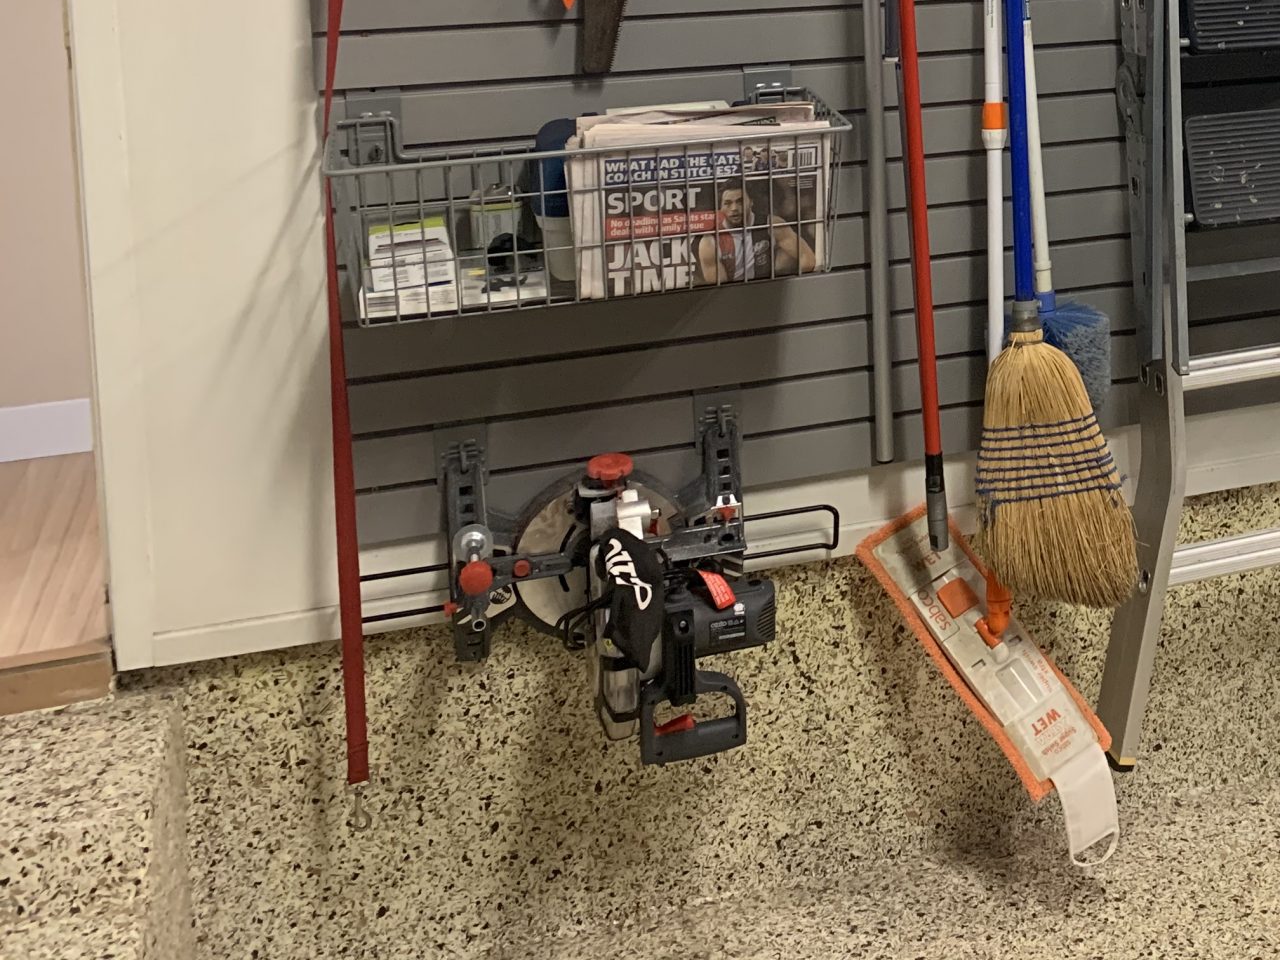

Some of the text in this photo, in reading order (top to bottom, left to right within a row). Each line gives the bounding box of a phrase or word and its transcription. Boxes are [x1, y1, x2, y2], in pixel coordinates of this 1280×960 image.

[607, 187, 702, 215] SPORT
[608, 236, 697, 270] JACK
[608, 265, 696, 296] TIME
[917, 589, 951, 631] sabco
[1031, 708, 1061, 737] WET
